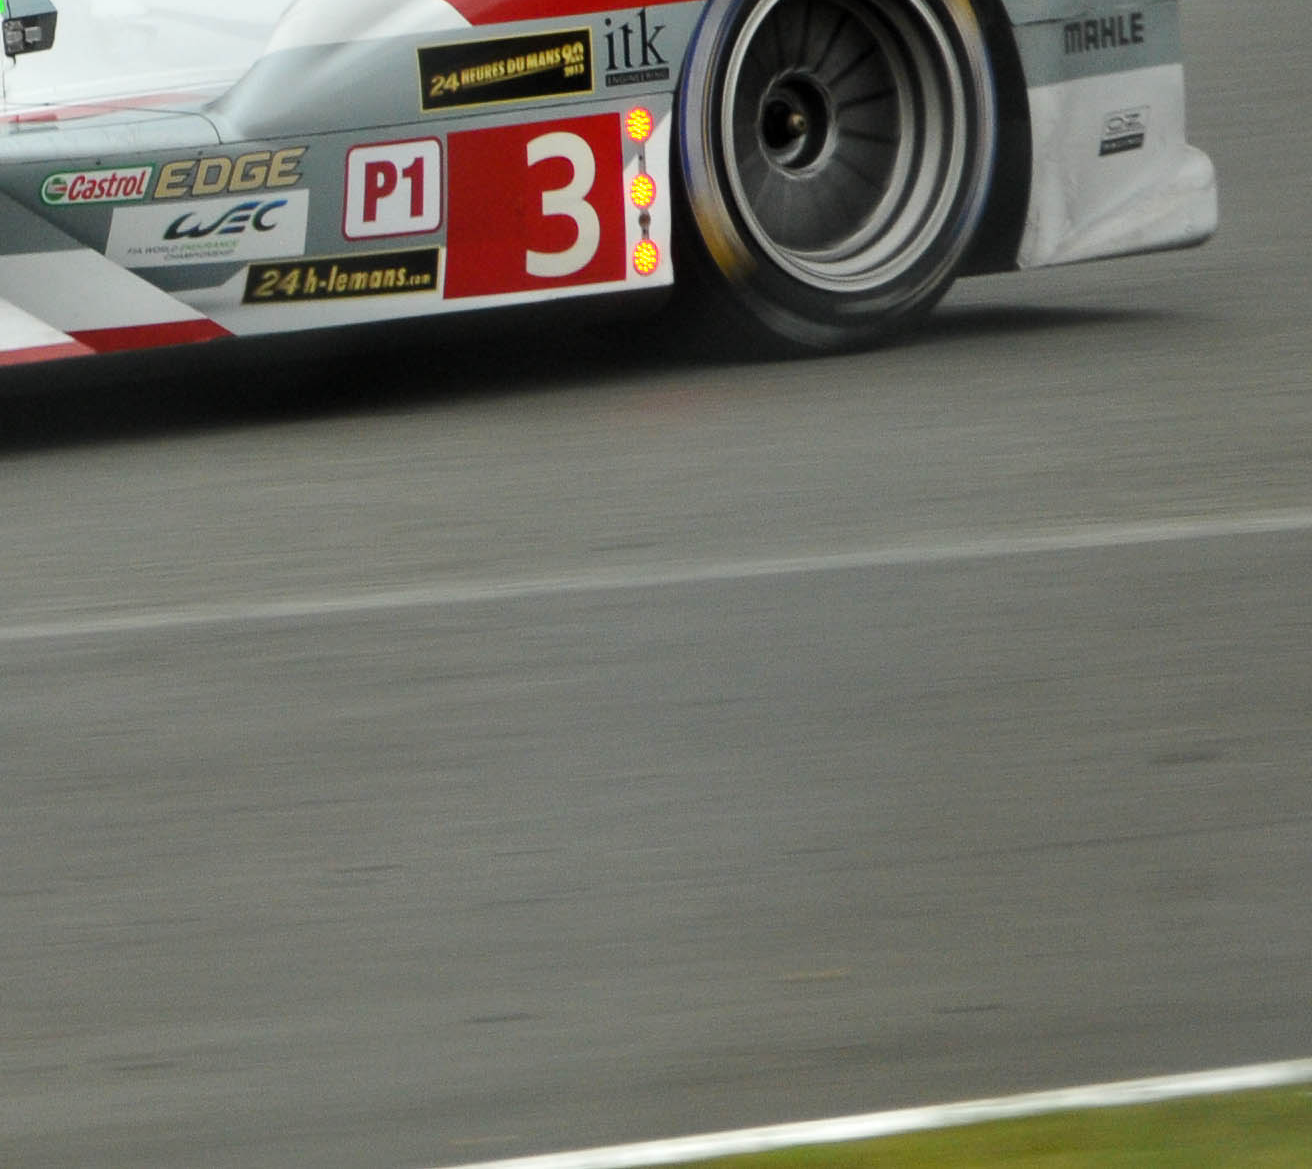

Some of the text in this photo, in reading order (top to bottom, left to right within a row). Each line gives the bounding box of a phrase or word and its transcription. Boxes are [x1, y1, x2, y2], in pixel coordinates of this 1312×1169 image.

[603, 6, 670, 70] itk
[1064, 12, 1144, 55] MAHLE
[430, 71, 459, 97] 24
[461, 60, 505, 86] HEURES
[507, 55, 525, 74] DU
[526, 48, 561, 70] MANS
[68, 145, 308, 201] Castrol EDGE
[362, 157, 424, 222] P1
[163, 199, 289, 240] WEC
[526, 131, 601, 278] 3
